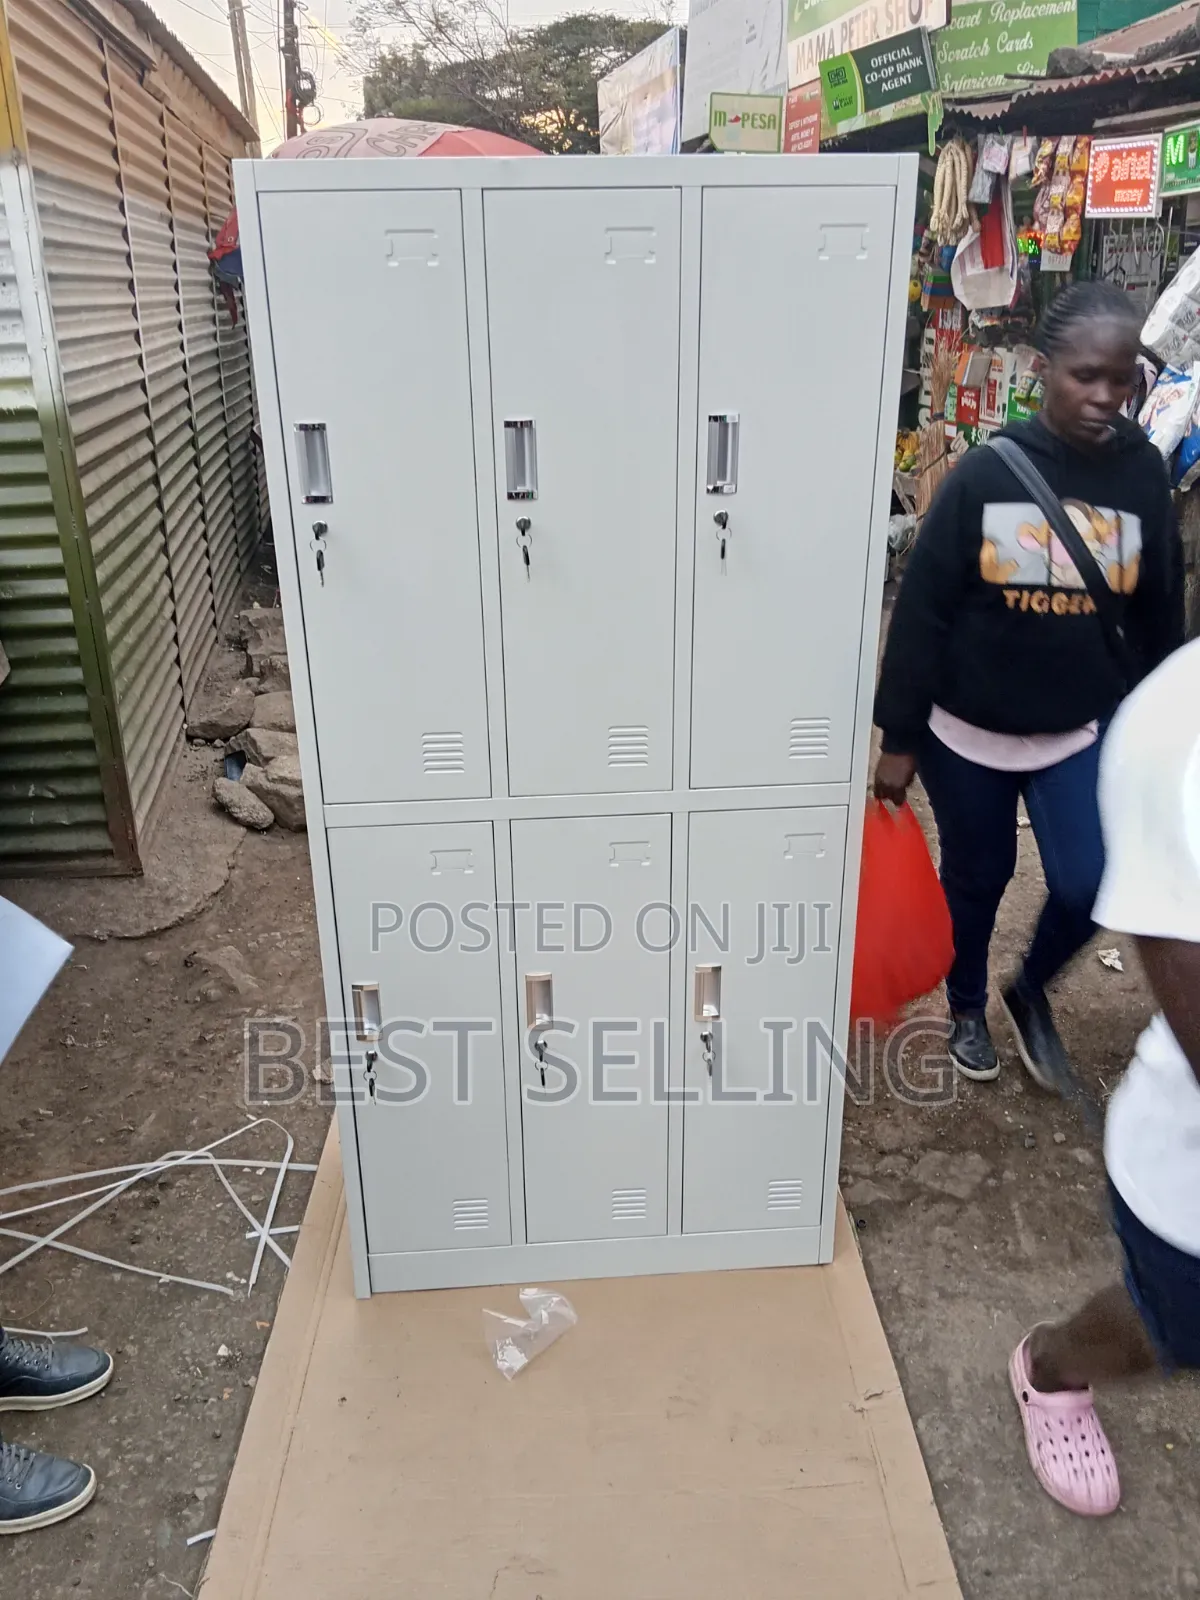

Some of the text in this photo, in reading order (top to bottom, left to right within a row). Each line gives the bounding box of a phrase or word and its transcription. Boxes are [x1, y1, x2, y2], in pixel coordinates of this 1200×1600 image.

[988, 0, 1077, 28] Replacement
[796, 28, 836, 75] MAMA
[840, 7, 880, 53] PETER
[936, 31, 1034, 64] Scratch Cards
[865, 62, 896, 85] CO-OP
[896, 57, 924, 78] BANK
[870, 47, 913, 69] OFFICIAL
[881, 73, 912, 93] AGENT
[940, 72, 1007, 94] Safaricom
[1111, 151, 1152, 182] airtel
